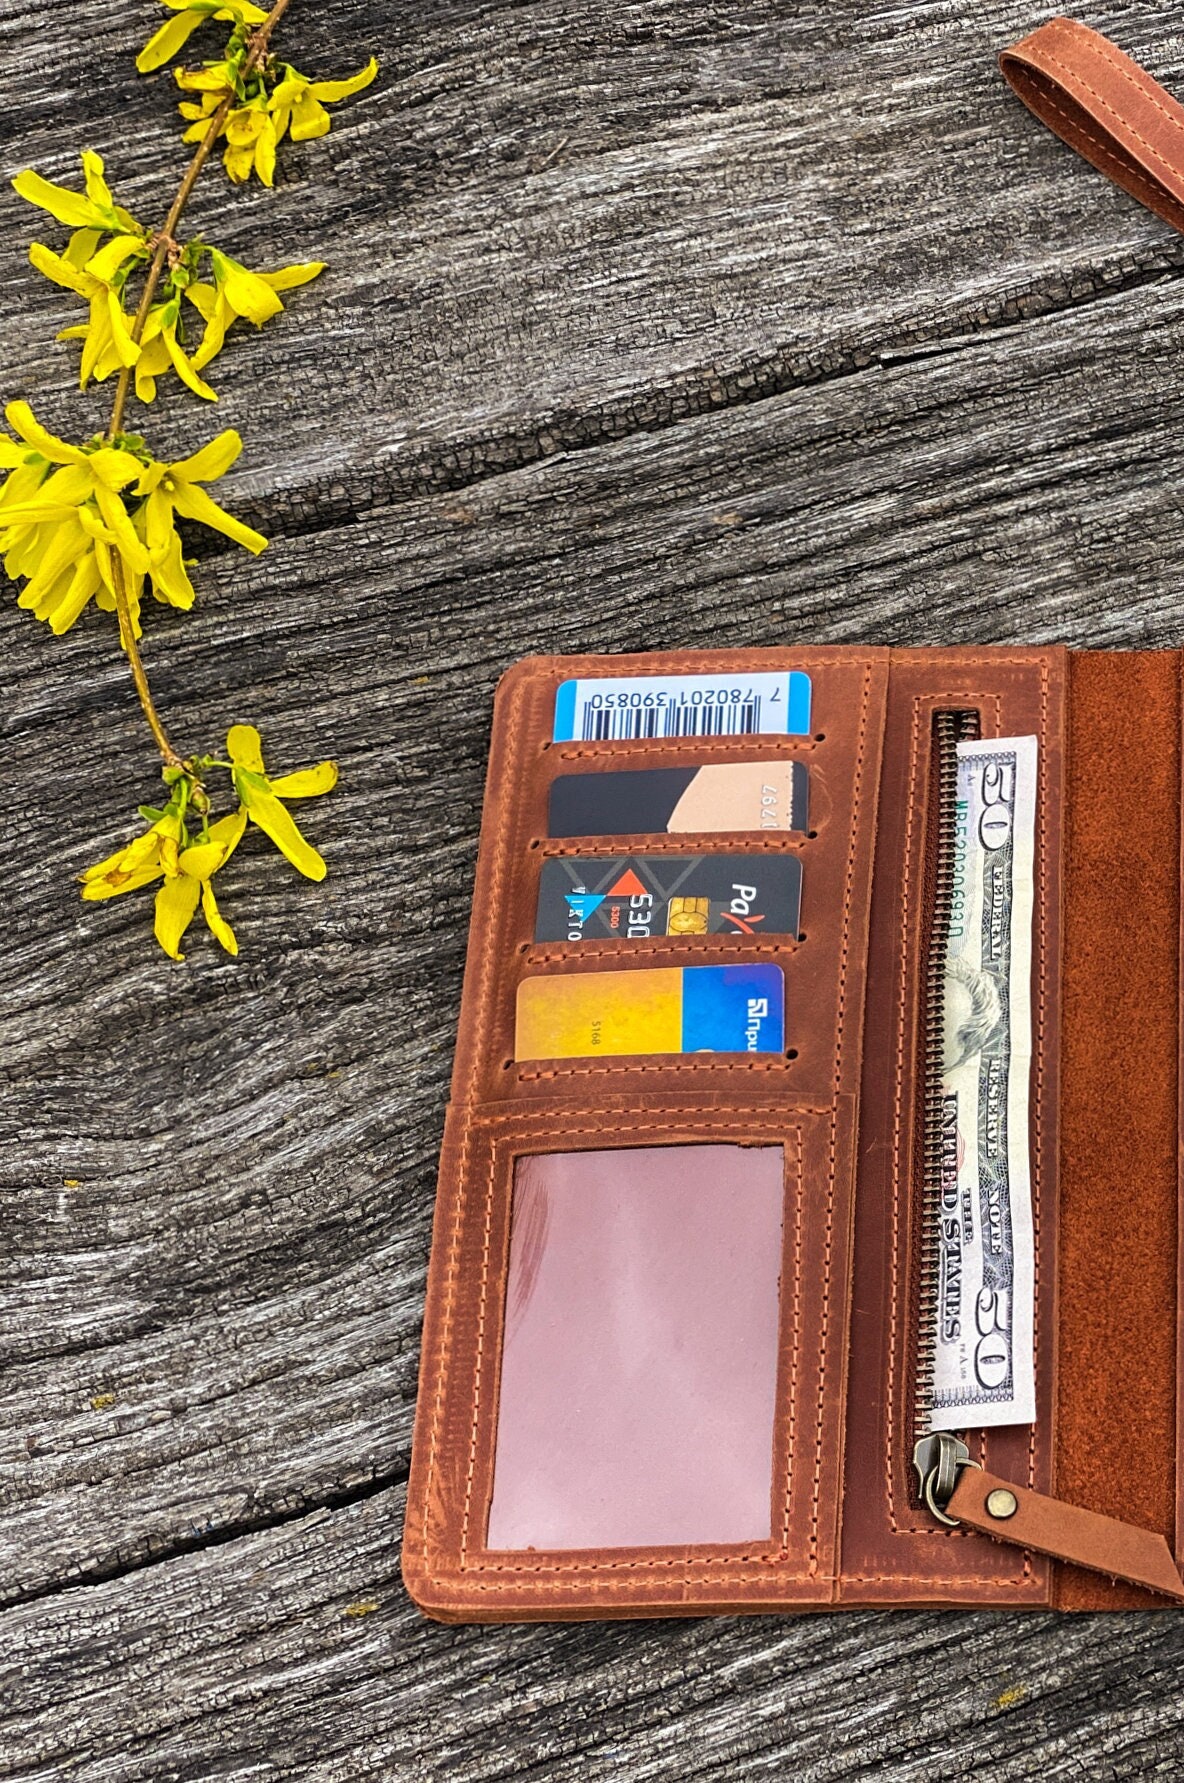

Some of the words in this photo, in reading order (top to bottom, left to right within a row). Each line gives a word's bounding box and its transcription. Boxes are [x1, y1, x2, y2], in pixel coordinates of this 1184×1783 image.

[591, 691, 668, 709] 390850
[680, 688, 754, 705] 780201
[769, 687, 781, 702] 7
[978, 761, 1015, 851] 50
[609, 906, 621, 929] 5300
[990, 864, 1004, 960] FEDERAL
[591, 1020, 602, 1046] 5168
[985, 1058, 1001, 1158] RESERVE
[941, 1090, 959, 1213] UNITED
[961, 1187, 974, 1246] THE
[987, 1189, 1003, 1255] NOTE
[940, 1218, 963, 1344] STATES
[973, 1287, 1008, 1390] 50
